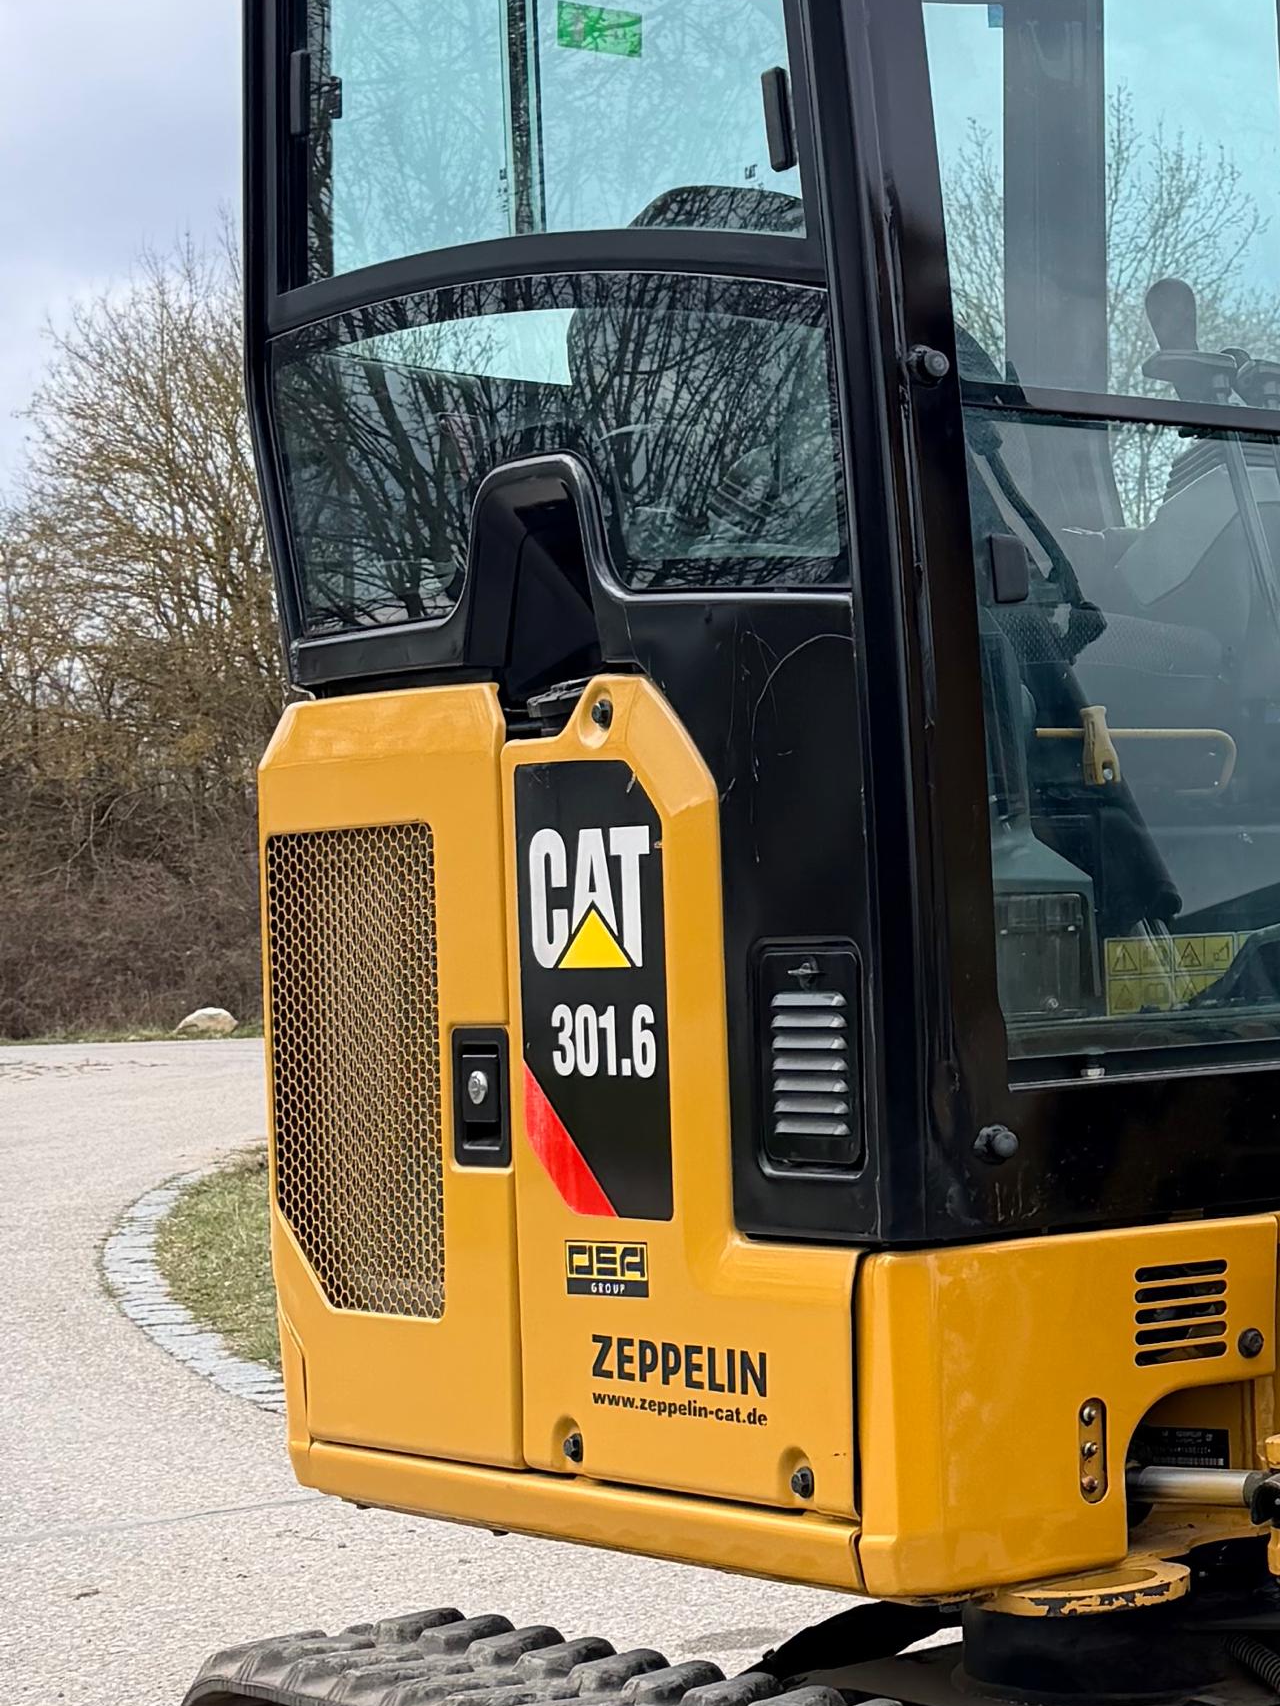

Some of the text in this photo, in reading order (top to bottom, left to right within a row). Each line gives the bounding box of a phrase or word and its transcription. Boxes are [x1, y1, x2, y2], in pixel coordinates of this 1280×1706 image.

[529, 825, 650, 969] CAT
[551, 1003, 657, 1079] 301.6
[590, 1281, 626, 1295] GROUP
[592, 1334, 768, 1398] ZEPPELIN
[592, 1392, 768, 1427] www.zeppelin-cat.de
